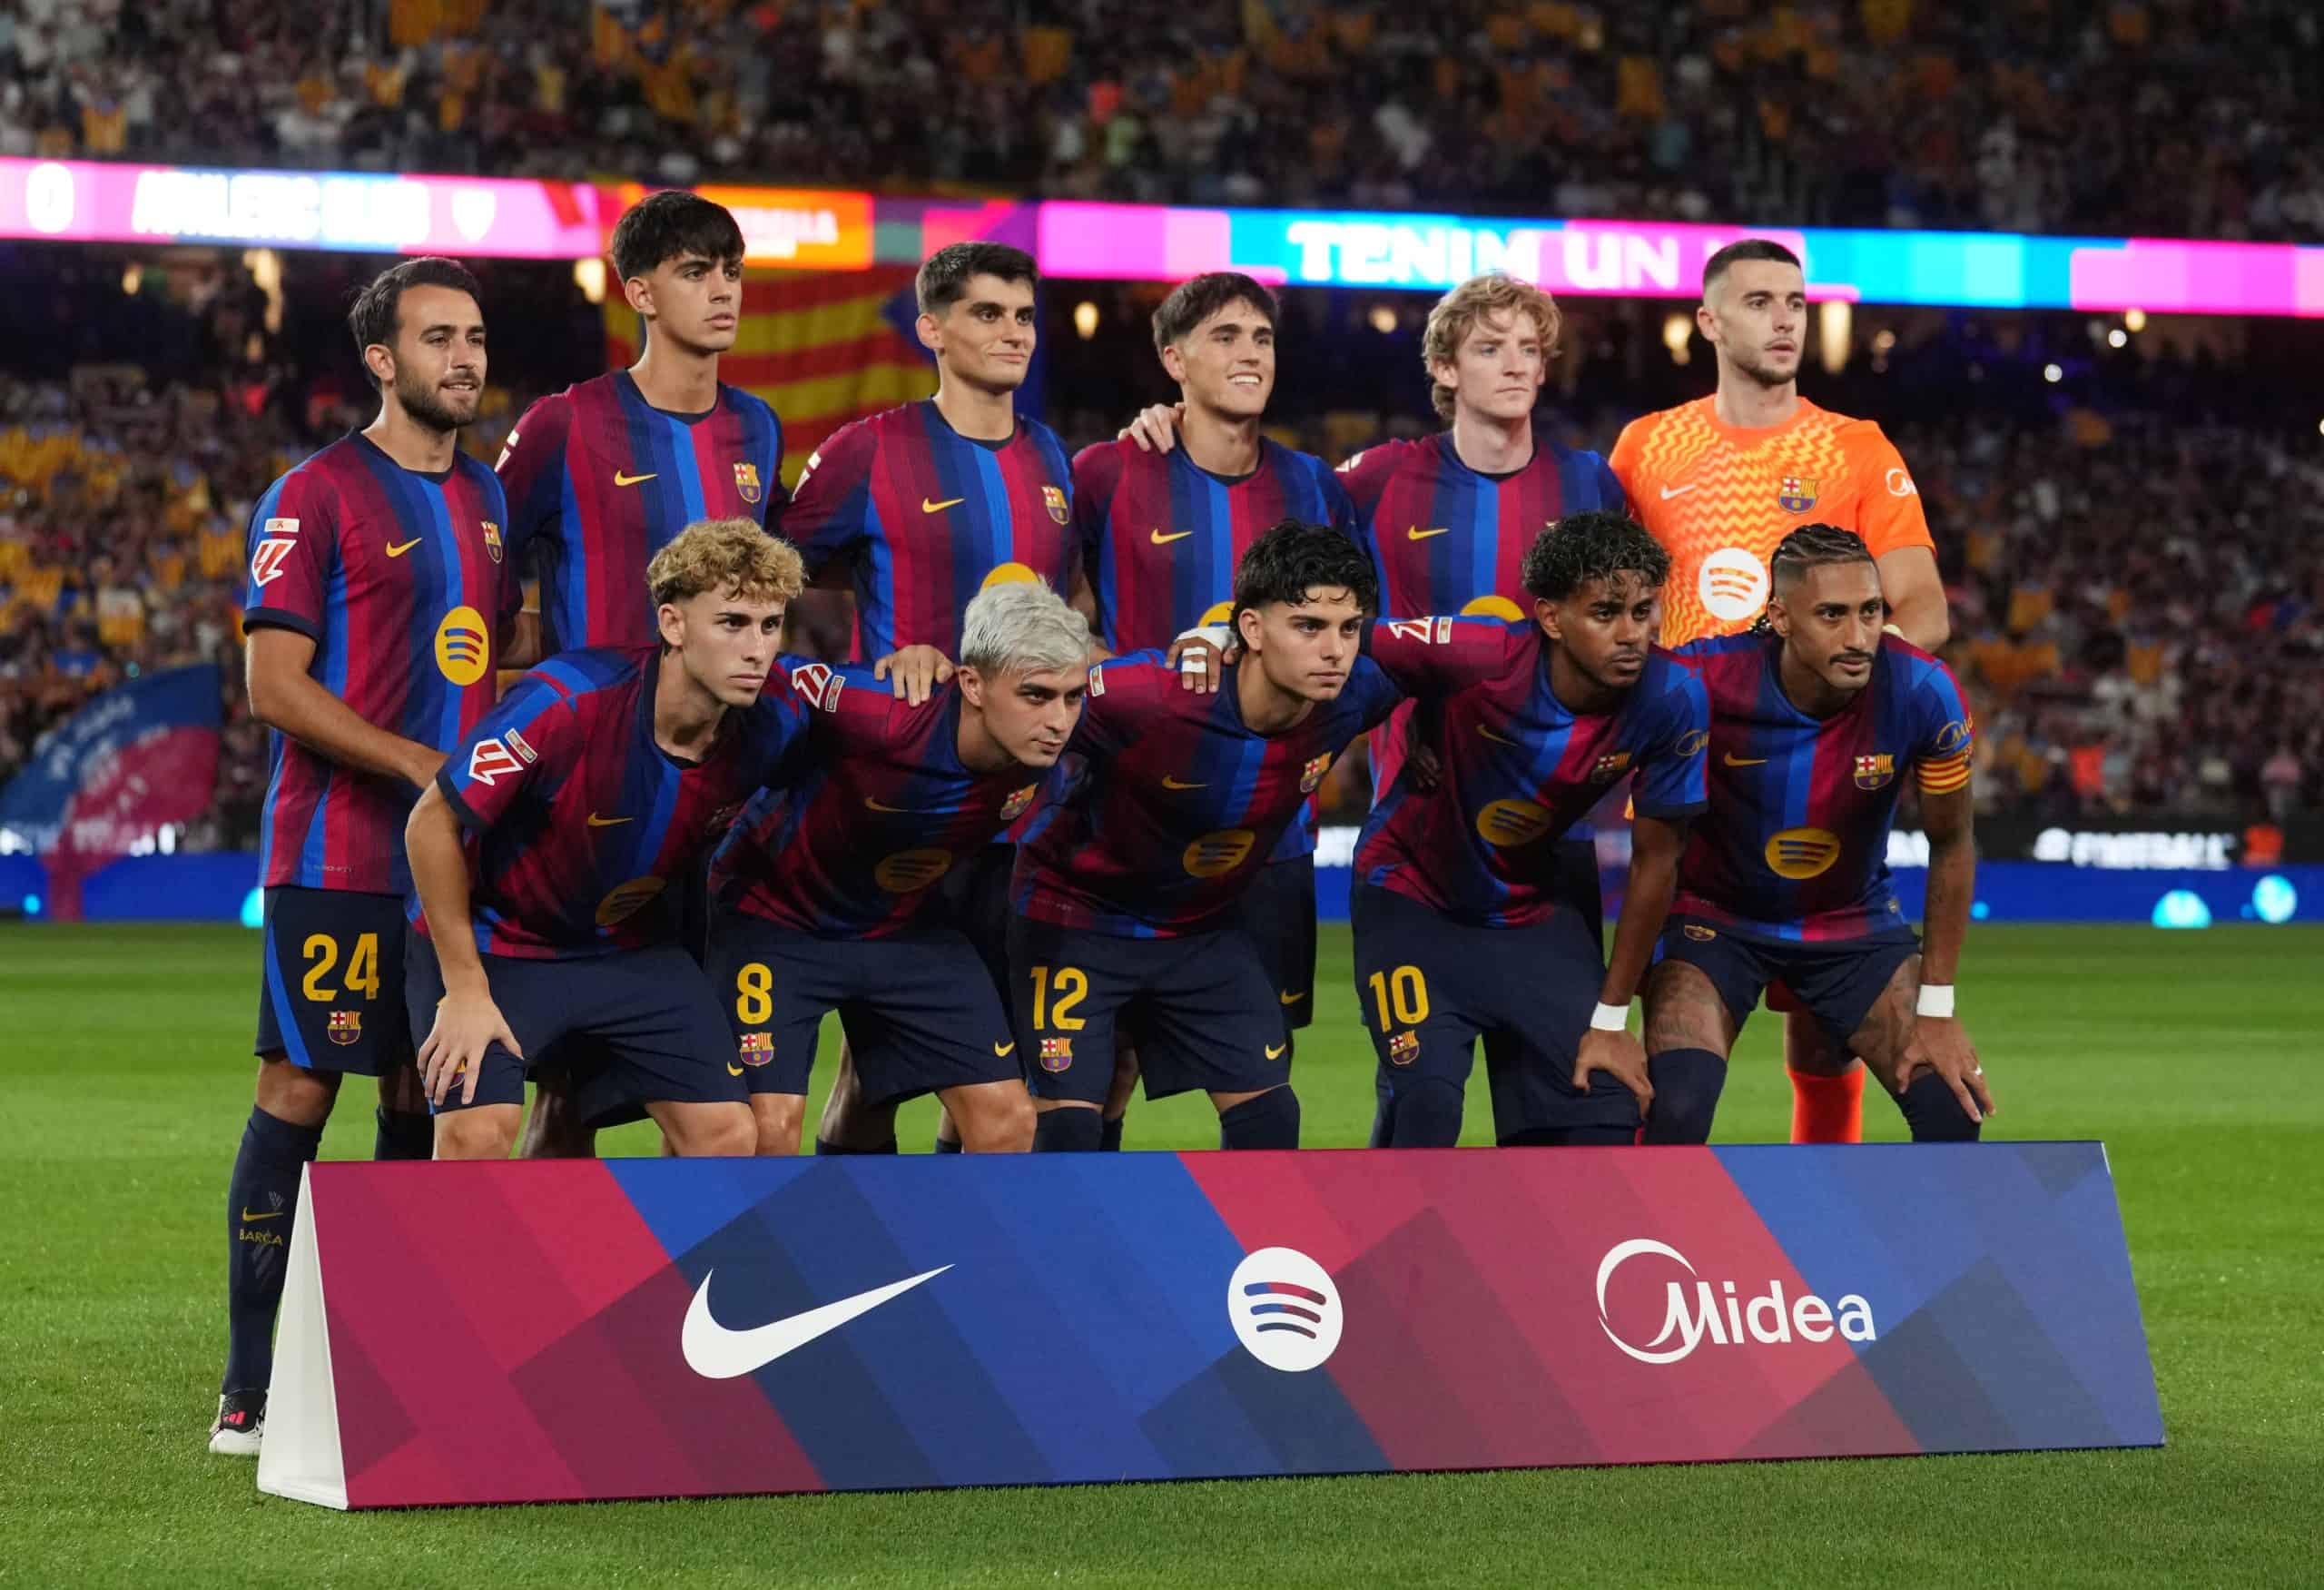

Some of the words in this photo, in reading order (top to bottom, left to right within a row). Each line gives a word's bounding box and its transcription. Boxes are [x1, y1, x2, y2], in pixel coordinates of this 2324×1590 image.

[1286, 222, 1541, 285] TENIM
[1564, 231, 1680, 290] UN
[302, 932, 379, 1002] 24
[736, 963, 773, 1024] 8
[1029, 965, 1088, 1031] 12
[1368, 964, 1430, 1033] 10
[1596, 1238, 1876, 1364] Midea
